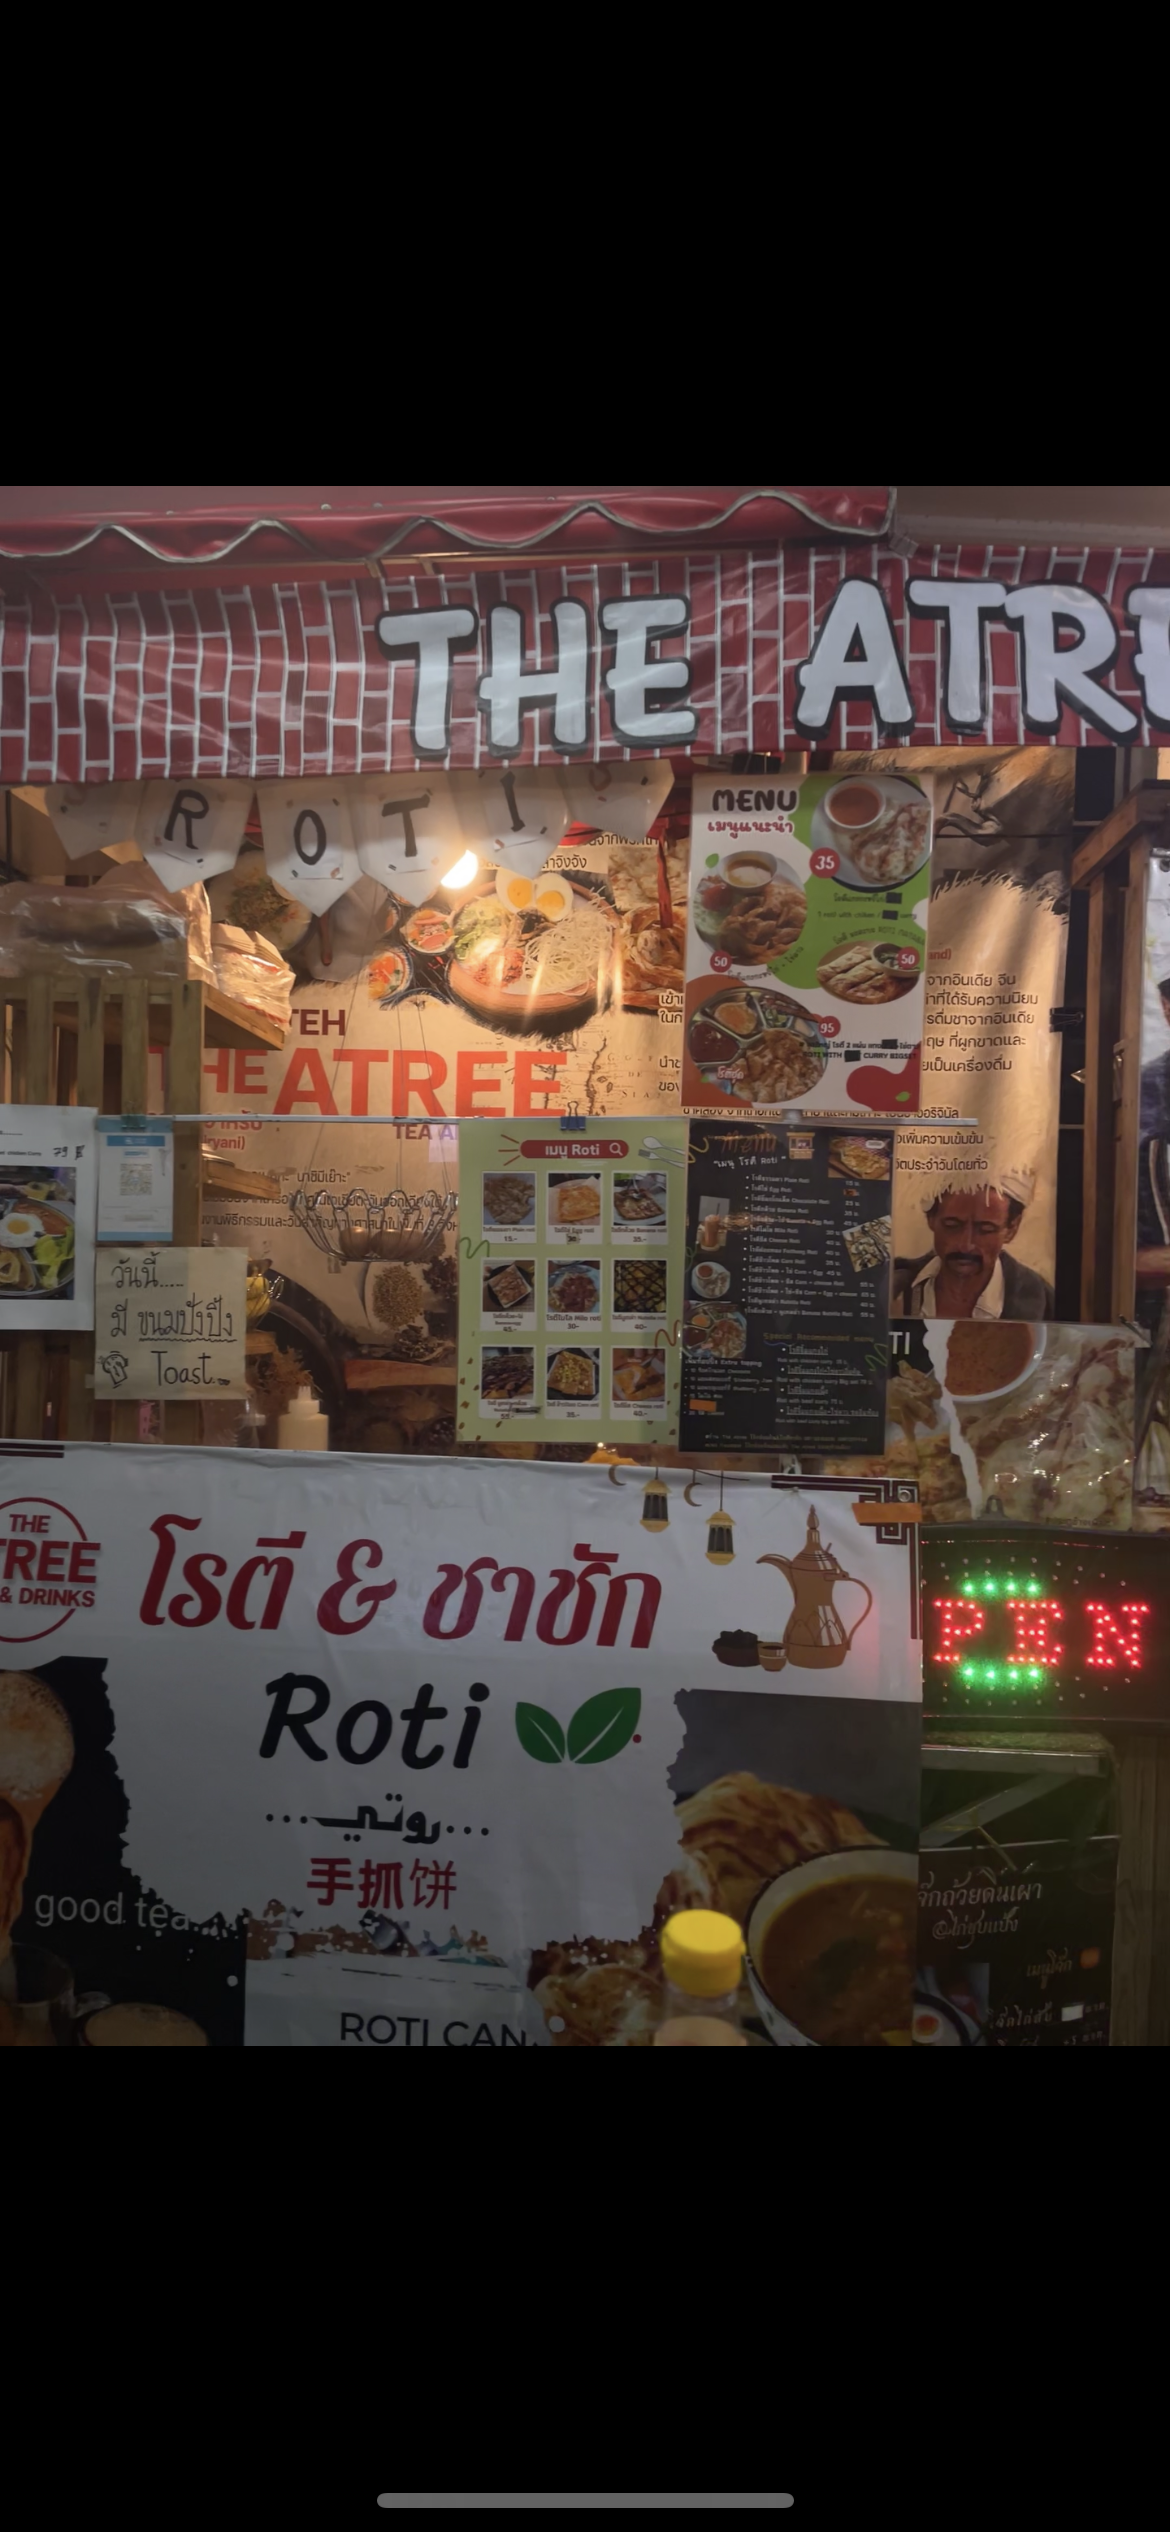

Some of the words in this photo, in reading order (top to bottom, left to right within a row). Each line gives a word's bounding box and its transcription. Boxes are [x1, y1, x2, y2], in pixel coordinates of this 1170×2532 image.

[376, 594, 698, 760] THE
[712, 788, 797, 812] MENU
[707, 815, 793, 839] เมนูแนะนำ
[814, 854, 835, 870] 35
[714, 956, 729, 968] 50
[901, 954, 915, 965] 50
[926, 973, 992, 987] จากอินเดีย
[820, 1021, 835, 1033] 95
[949, 1031, 1027, 1052] ที่ผูกขาดและ
[863, 1051, 888, 1059] CURRY
[272, 1047, 568, 1118] ATREE
[392, 1123, 432, 1140] TEA
[572, 1144, 600, 1156] Roti
[110, 1298, 129, 1338] มี
[888, 1331, 911, 1355] TI
[9, 1513, 51, 1534] THE
[0, 1538, 102, 1584] REE
[139, 1513, 308, 1631] โรตี
[316, 1538, 398, 1636] &
[421, 1542, 663, 1650] ชาชัก
[0, 1586, 13, 1605] &
[19, 1588, 96, 1609] DRINKS
[931, 1599, 1150, 1668] PEN
[259, 1671, 491, 1770] Roti
[306, 1858, 458, 1911] 手抓饼
[34, 1891, 126, 1928] good
[339, 2013, 428, 2046] ROTI
[443, 2018, 540, 2046] CAN
